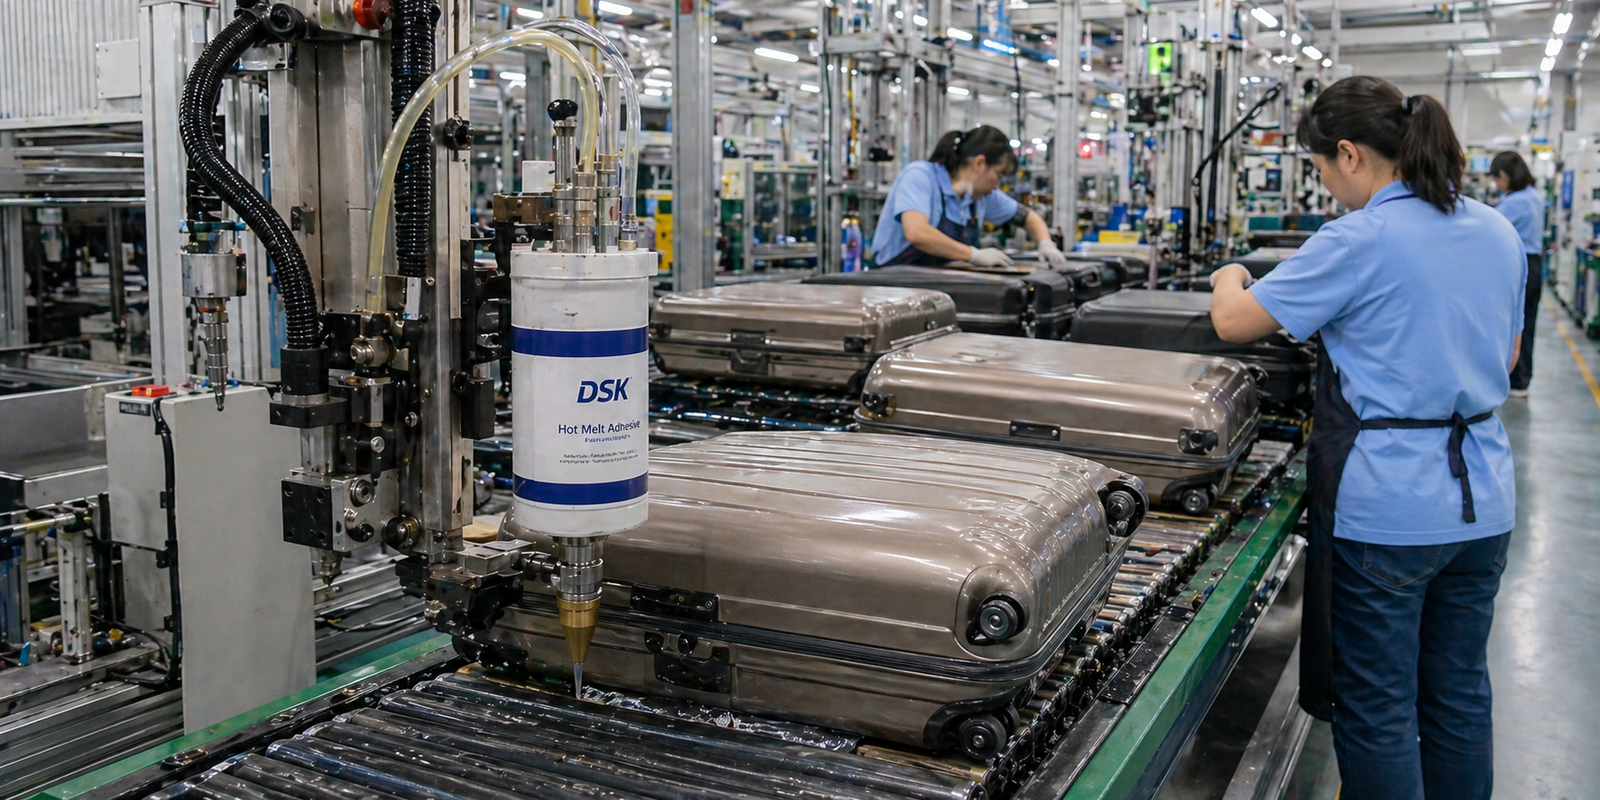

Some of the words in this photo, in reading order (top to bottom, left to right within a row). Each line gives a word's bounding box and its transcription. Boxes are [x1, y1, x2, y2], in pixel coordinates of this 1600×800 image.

[577, 377, 630, 404] DSK
[558, 424, 578, 435] Hot
[581, 423, 605, 434] Melt
[607, 420, 641, 433] Adhesive
